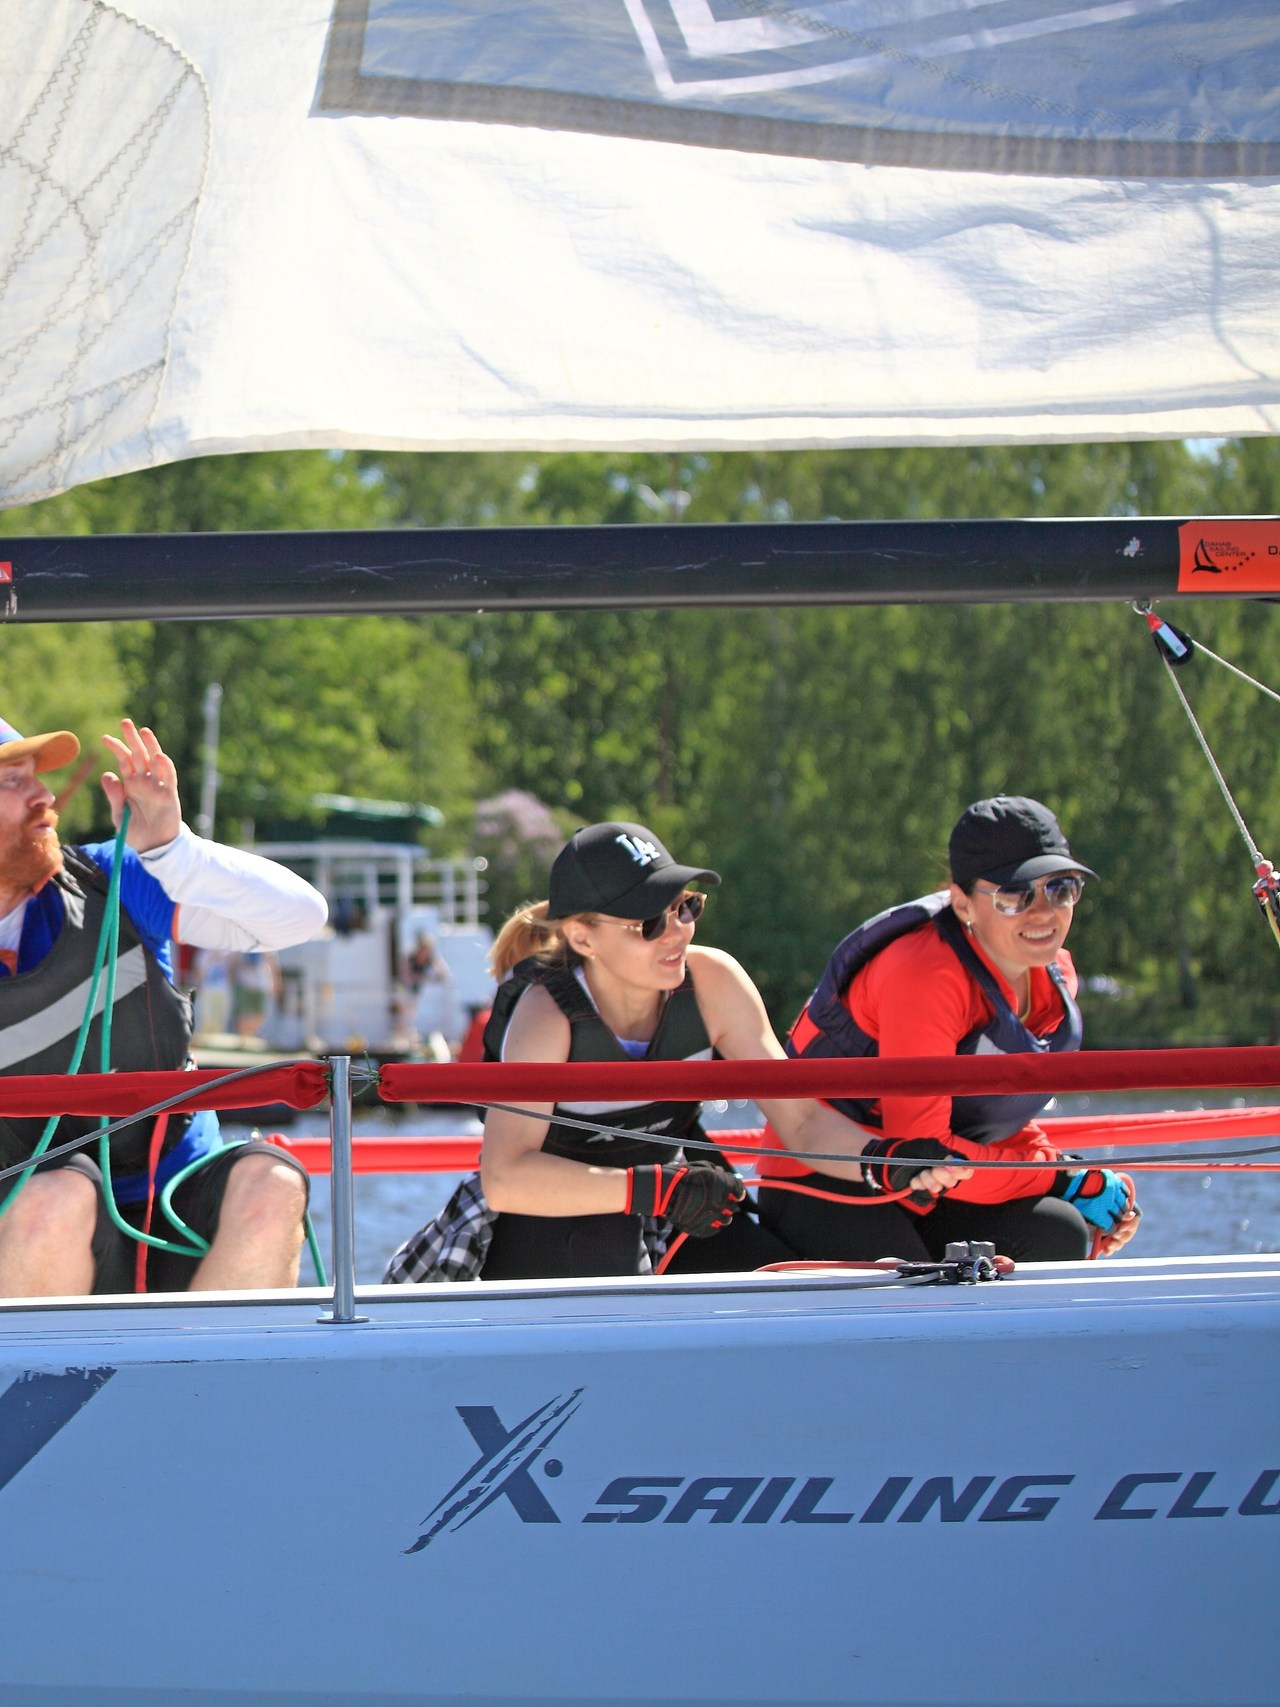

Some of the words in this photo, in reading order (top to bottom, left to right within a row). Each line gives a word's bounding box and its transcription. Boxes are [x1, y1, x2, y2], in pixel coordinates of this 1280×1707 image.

[1268, 546, 1280, 555] D
[615, 833, 661, 867] LA
[581, 1475, 1076, 1524] SAILING
